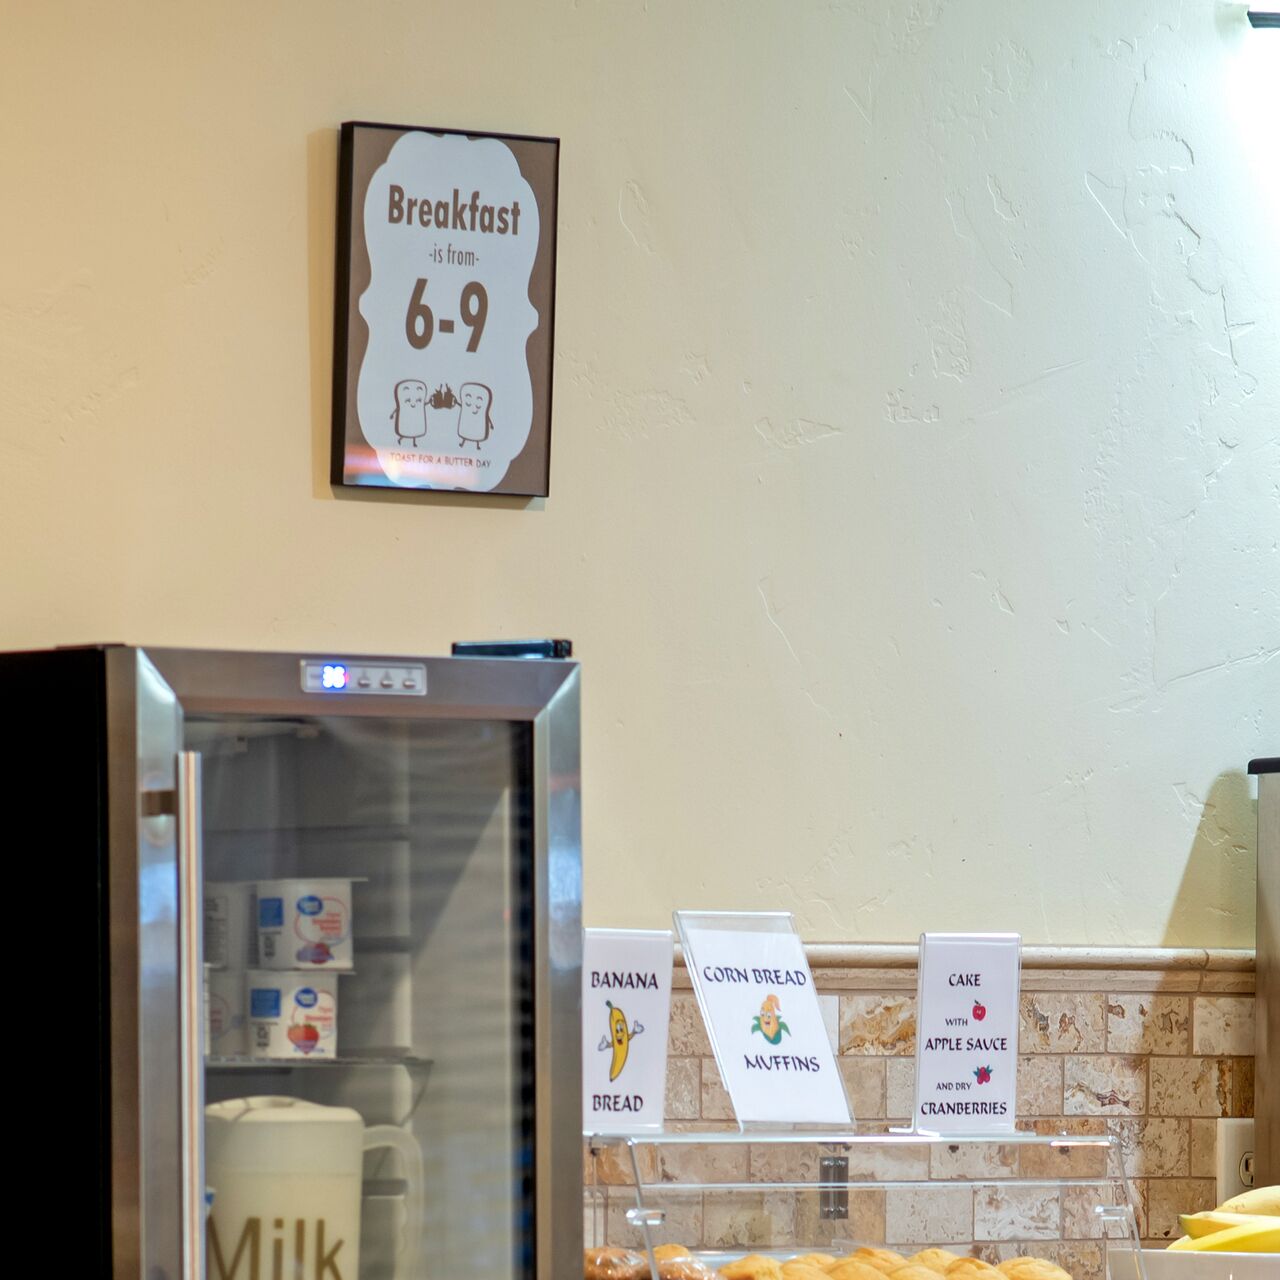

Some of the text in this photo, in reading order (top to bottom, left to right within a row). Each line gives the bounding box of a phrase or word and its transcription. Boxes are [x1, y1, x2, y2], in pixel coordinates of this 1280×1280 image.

[388, 184, 520, 235] Breakfast
[405, 278, 488, 353] 6-9
[390, 452, 491, 468] TOAST FOR A BUTTER DAY
[591, 971, 659, 990] BANANA
[703, 966, 806, 986] CORN BREAD
[948, 973, 981, 987] CAKE
[945, 1018, 968, 1026] WITH
[925, 1038, 1007, 1051] APPLE SAUCE
[744, 1054, 820, 1072] MUFFINS
[936, 1082, 972, 1091] AND DRY
[592, 1094, 643, 1112] BREAD
[921, 1102, 1007, 1116] CRANBERRIES
